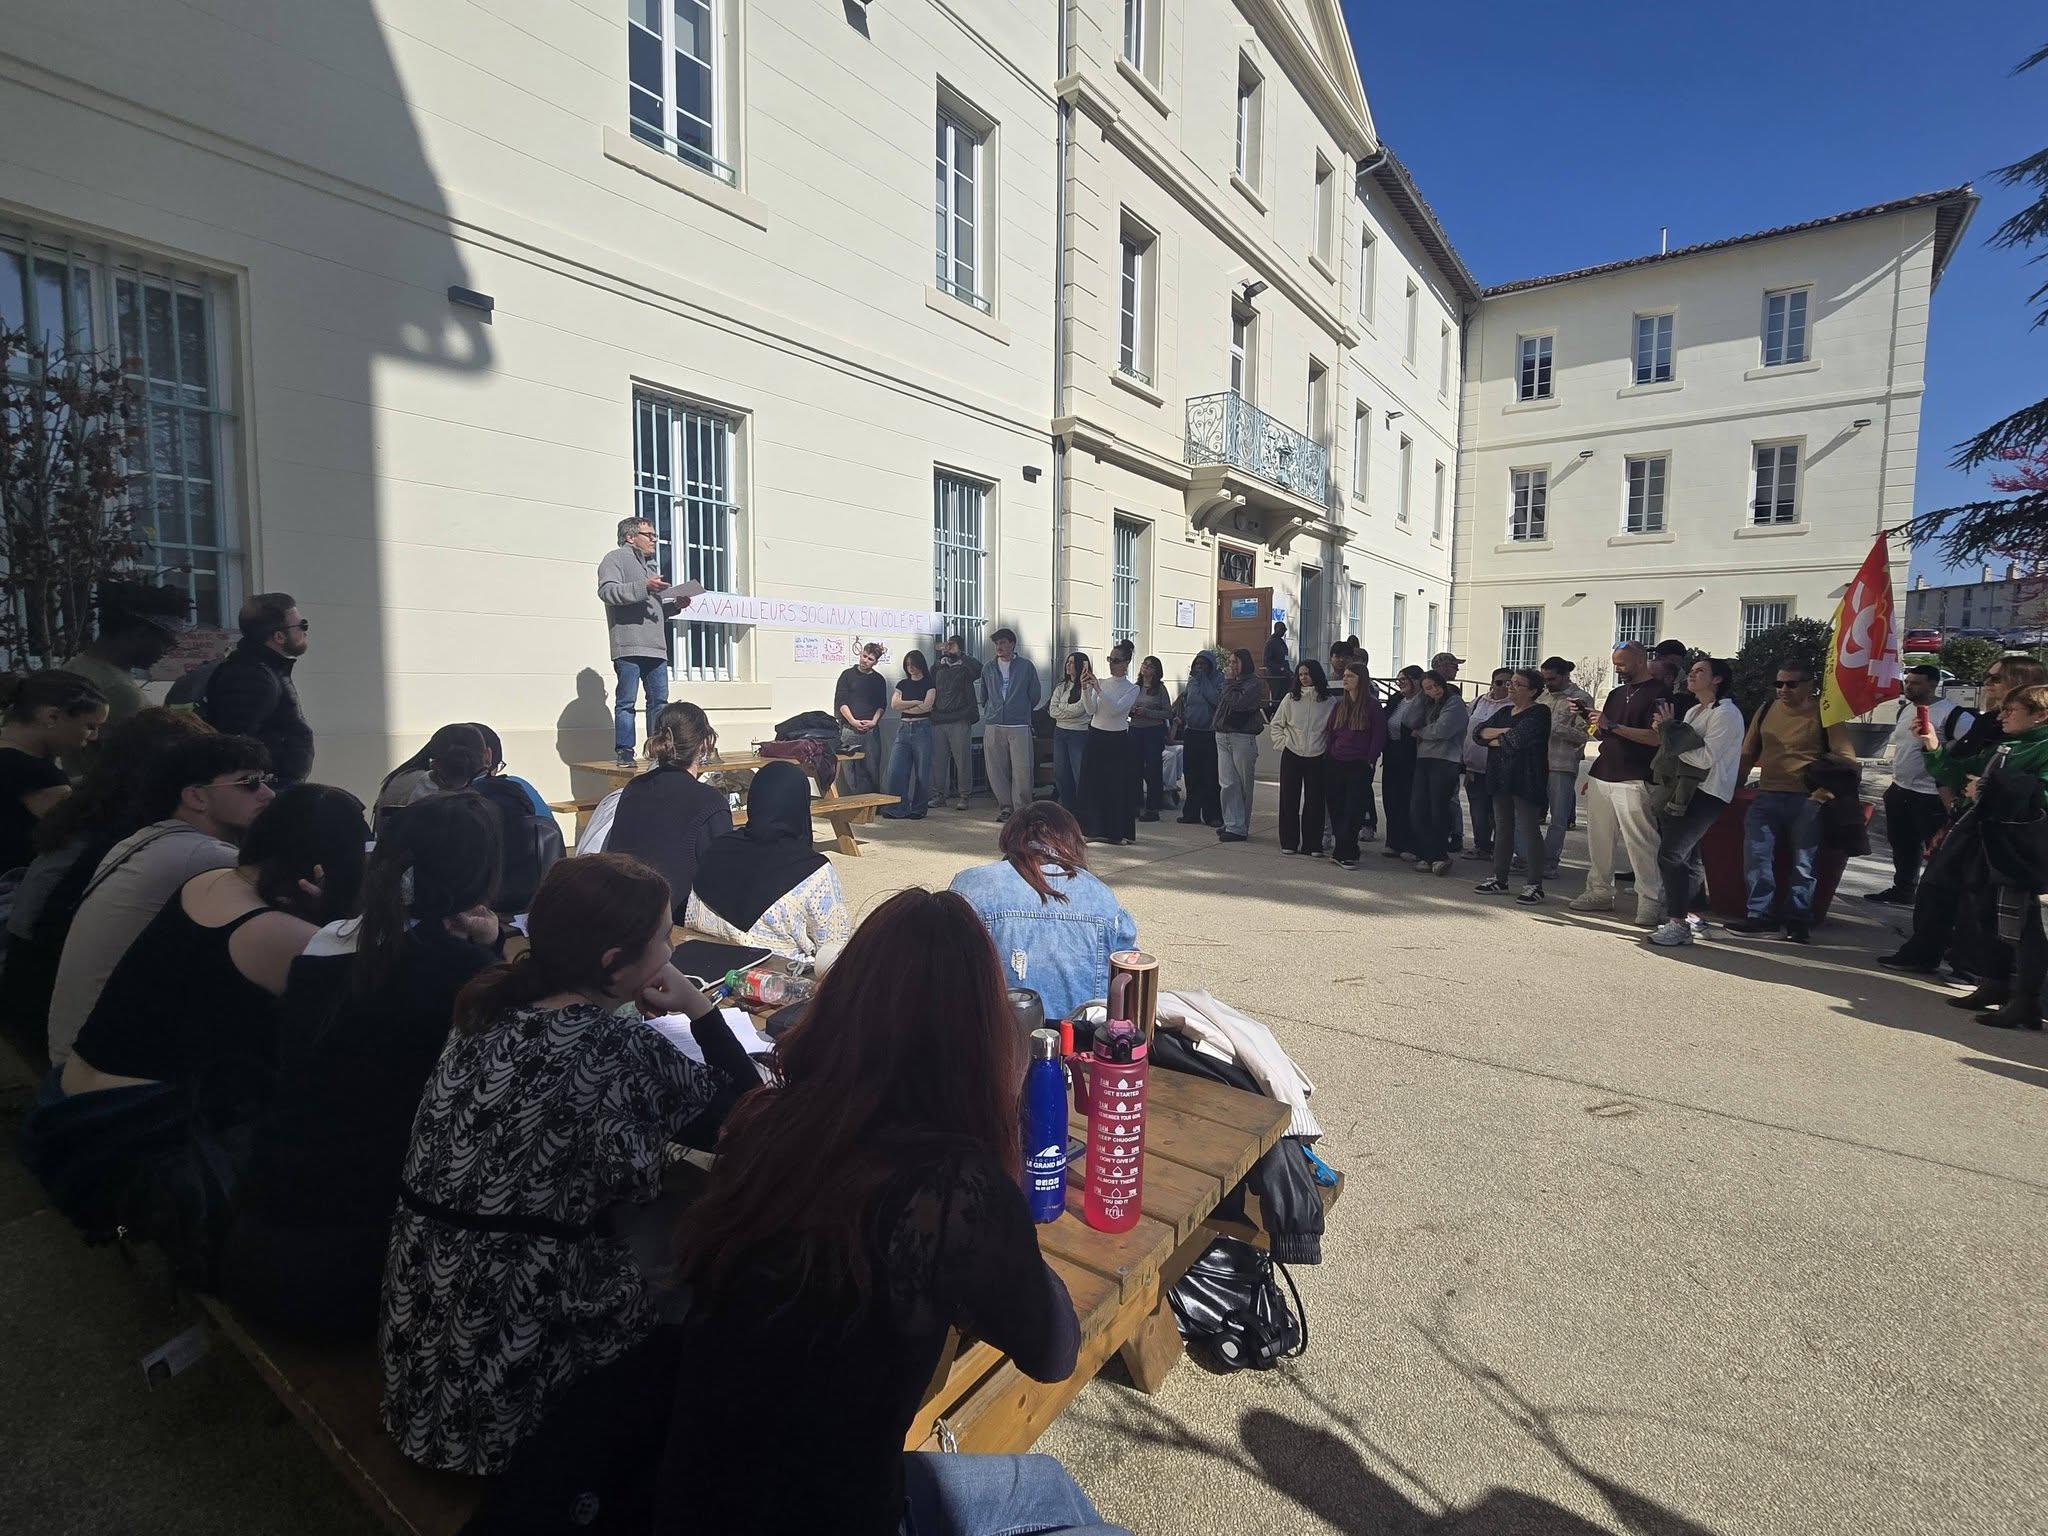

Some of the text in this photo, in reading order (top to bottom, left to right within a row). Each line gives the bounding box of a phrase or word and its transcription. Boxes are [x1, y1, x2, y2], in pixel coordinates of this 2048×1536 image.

[801, 605, 856, 625] SOCIAUX
[861, 611, 878, 628] EN
[1116, 1090, 1140, 1098] STARTED
[1026, 1160, 1033, 1168] LE
[1099, 1156, 1115, 1164] DON'T
[1096, 1176, 1136, 1185] ALMOST THERE
